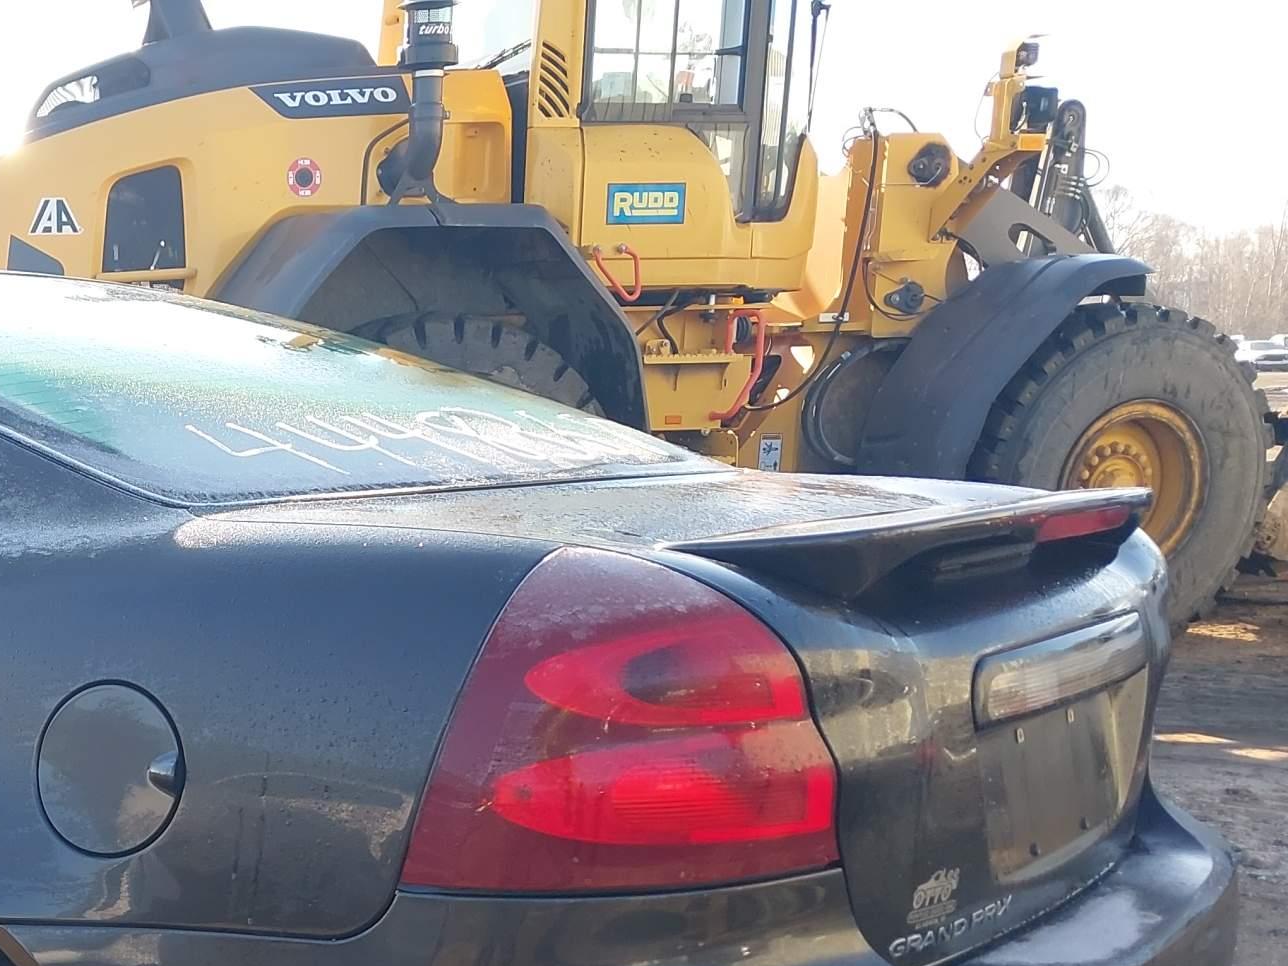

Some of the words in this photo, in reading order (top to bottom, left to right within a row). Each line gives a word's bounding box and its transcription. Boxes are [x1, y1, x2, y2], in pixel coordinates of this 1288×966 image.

[273, 87, 397, 108] VOLVO
[613, 191, 679, 217] RUDD
[888, 917, 968, 958] GRAND
